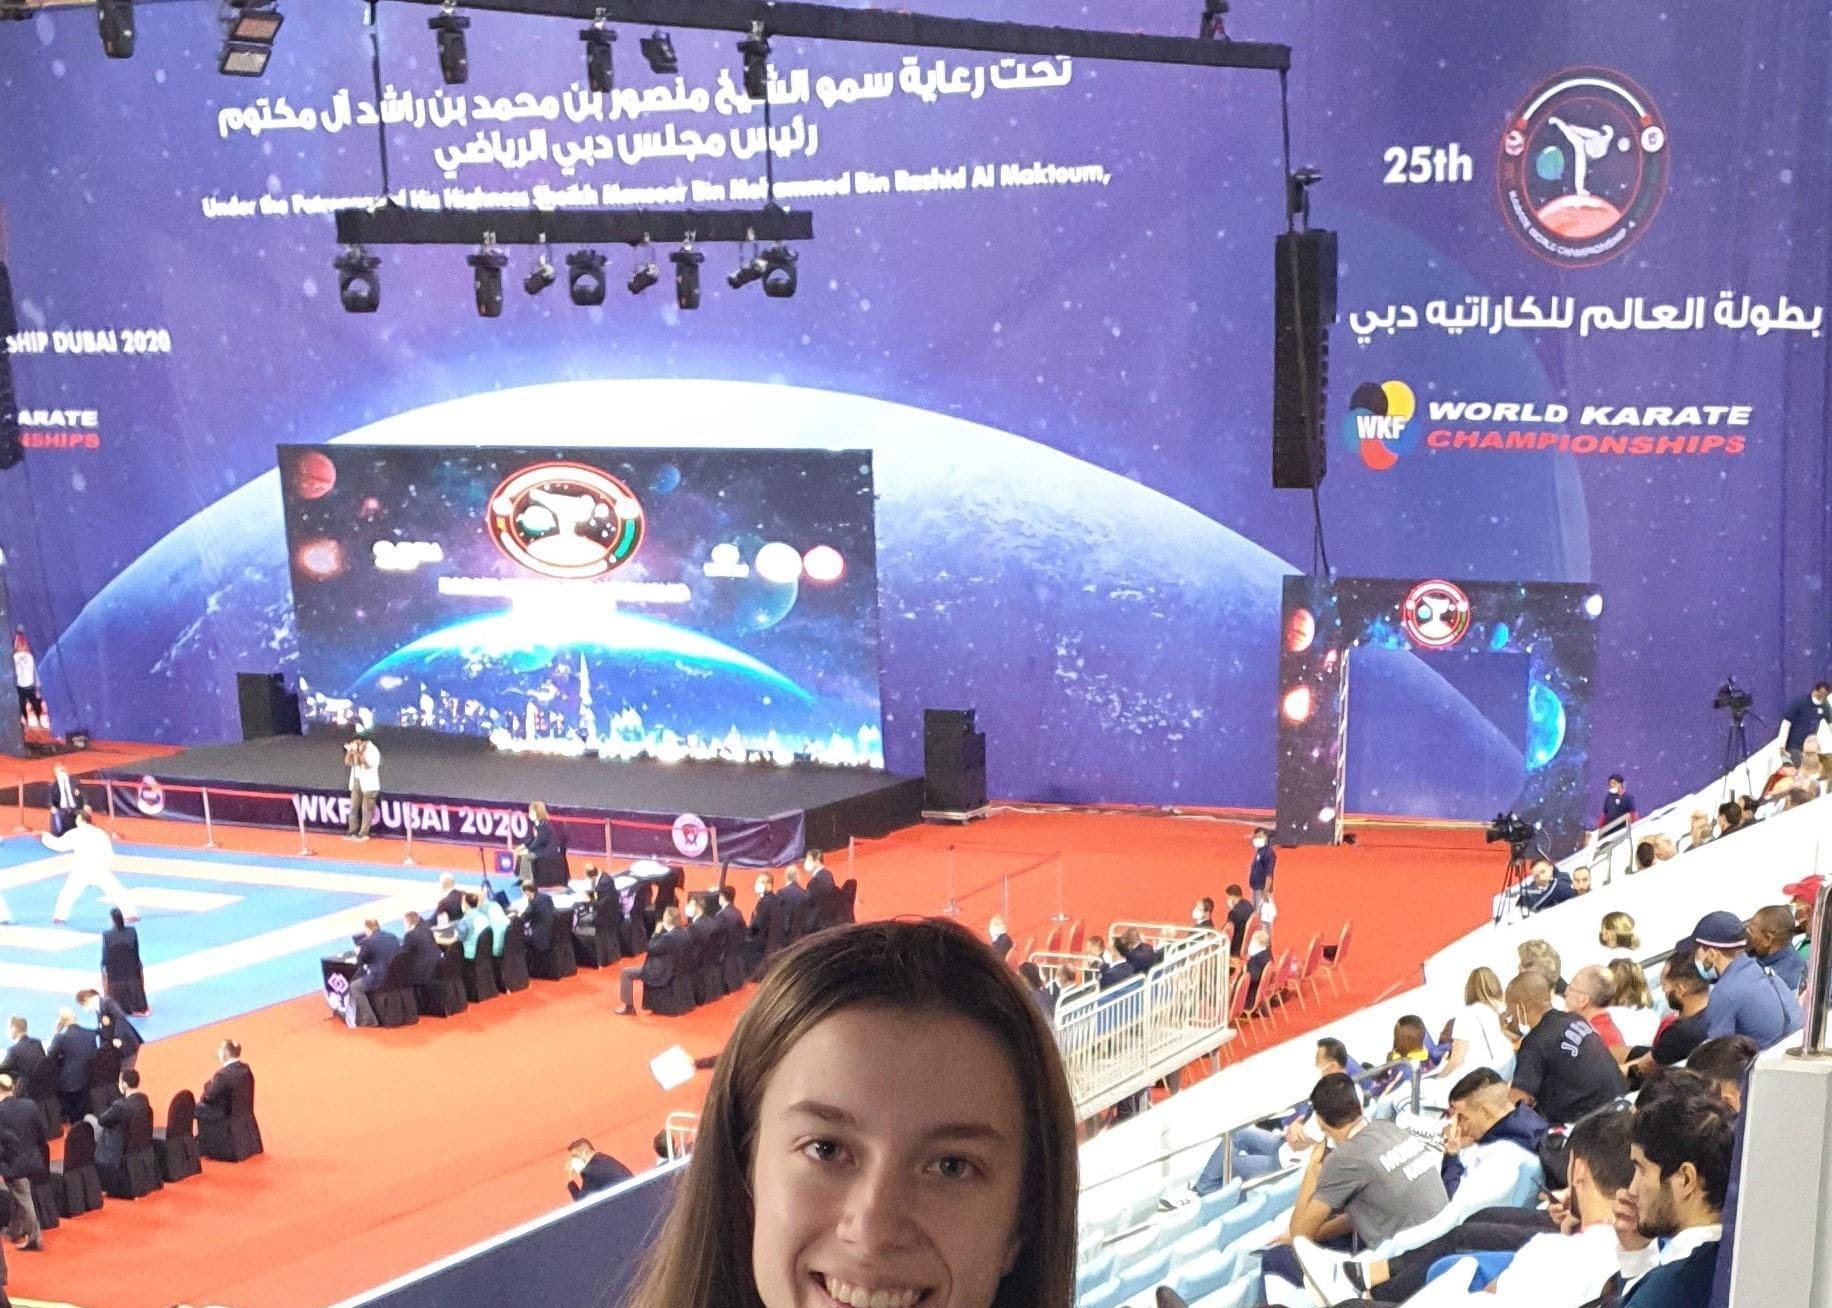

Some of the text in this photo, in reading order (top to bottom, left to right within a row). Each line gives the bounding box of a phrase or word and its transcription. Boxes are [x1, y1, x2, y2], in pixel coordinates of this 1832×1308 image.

[815, 72, 894, 108] سمو
[900, 56, 985, 103] رعاية
[990, 55, 1072, 89] تحت
[218, 97, 317, 137] مكتوم
[321, 88, 352, 132] آل
[356, 84, 425, 128] راشد
[429, 89, 467, 127] بن
[471, 92, 559, 121] محمد
[563, 82, 603, 122] بن
[609, 77, 709, 120] منصور
[434, 114, 818, 179] رئيس مجلس دبي الرياضي
[1383, 142, 1472, 183] 25th
[202, 195, 255, 217] Under
[260, 194, 288, 215] the
[691, 180, 726, 201] Bin
[854, 171, 890, 193] Bin
[894, 166, 967, 192] Rashid
[971, 164, 996, 188] Al
[1348, 291, 1823, 345] بطولة العالم للكاراتيه دبي
[52, 329, 118, 353] DUBAI
[121, 329, 172, 353] 2020
[5, 410, 99, 426] ARATE
[1356, 415, 1407, 440] WKF
[1428, 402, 1753, 426] WORLD KARATE
[1426, 429, 1747, 455] CHAMPIONSHIPS
[370, 798, 450, 832] UBAI
[459, 807, 529, 839] 2020
